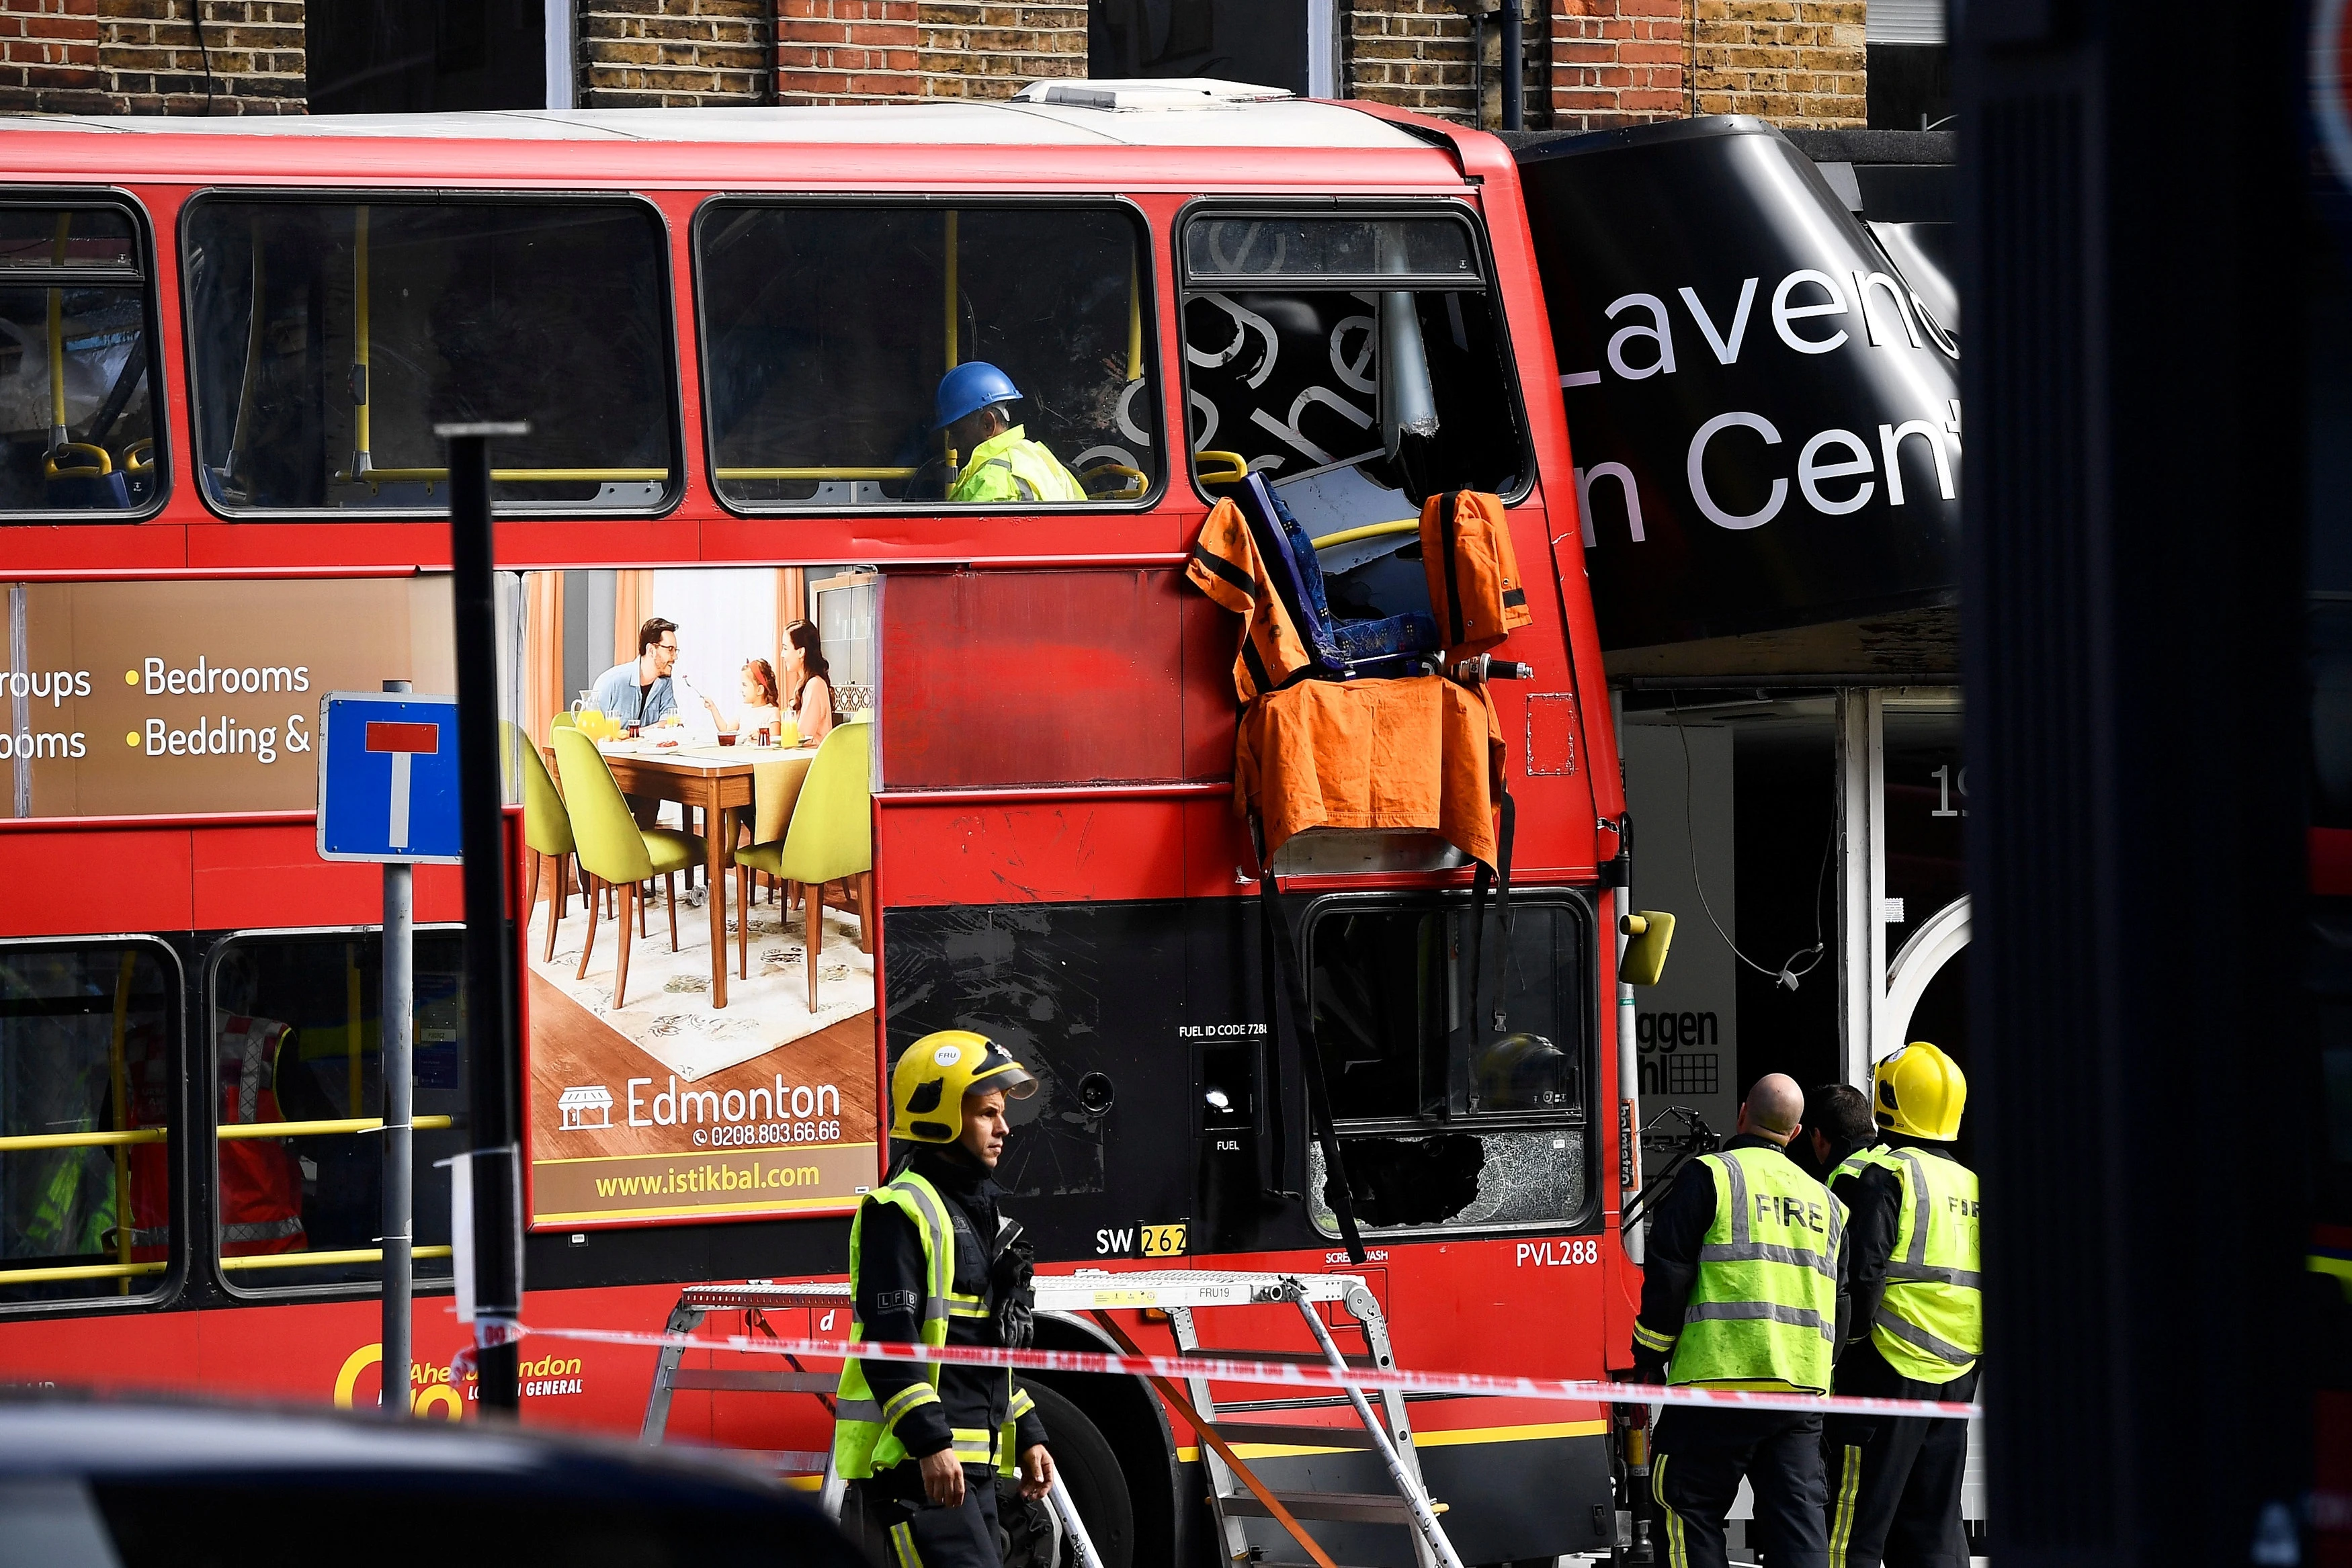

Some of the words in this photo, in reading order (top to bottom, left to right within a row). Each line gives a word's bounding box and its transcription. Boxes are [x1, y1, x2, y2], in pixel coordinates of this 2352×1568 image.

[143, 655, 310, 695] Bedrooms
[144, 715, 277, 764] Bedding
[284, 713, 311, 753] &
[1179, 1026, 1204, 1037] FUEL
[1206, 1025, 1216, 1036] ID
[1217, 1025, 1246, 1035] CODE
[627, 1073, 841, 1128] Edmonton
[711, 1119, 841, 1147] 0208.803.66.66
[1217, 1141, 1240, 1151] FUEL
[595, 1162, 821, 1199] www.istikbal.com
[1755, 1193, 1824, 1234] FIRE
[1095, 1228, 1134, 1254] SW
[1142, 1227, 1186, 1252] 262
[1516, 1239, 1599, 1268] PVL288
[1200, 1287, 1230, 1298] FRU19
[526, 1378, 583, 1397] GENERAL
